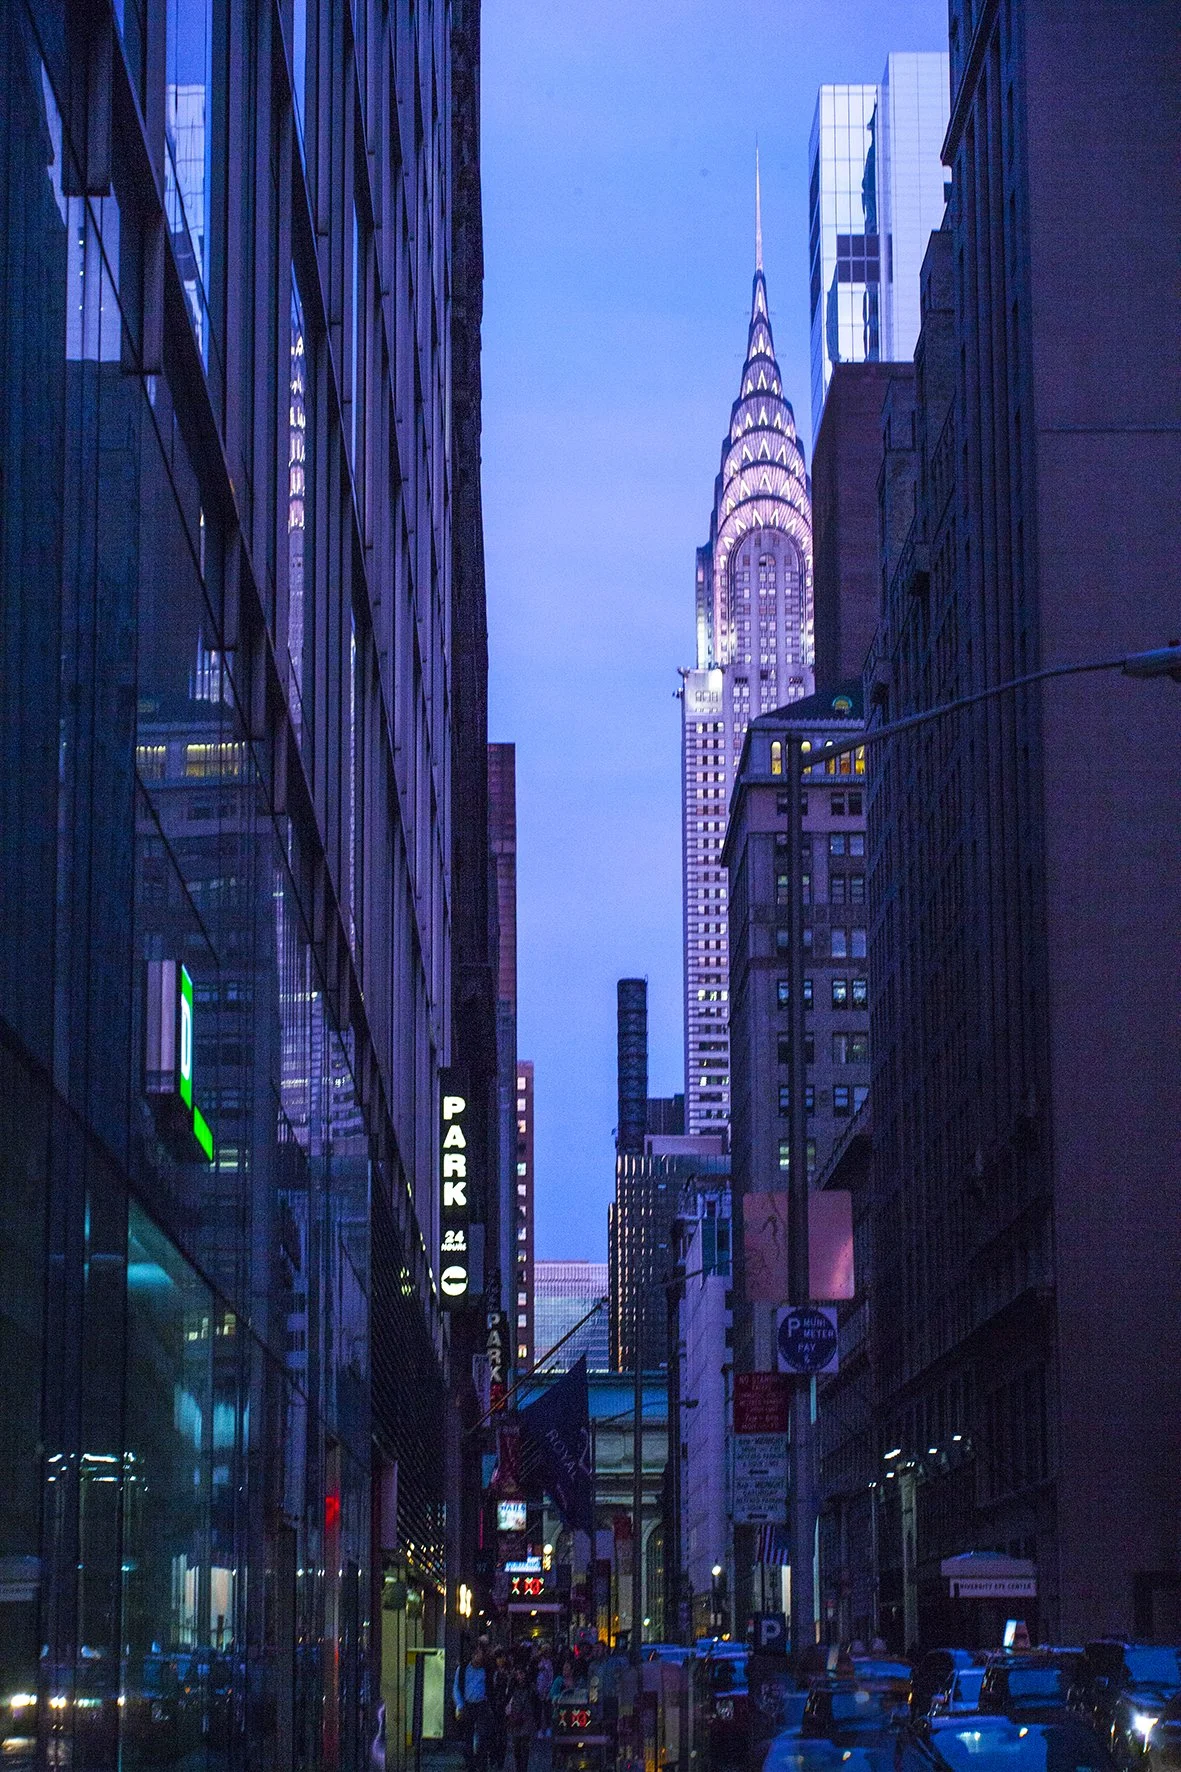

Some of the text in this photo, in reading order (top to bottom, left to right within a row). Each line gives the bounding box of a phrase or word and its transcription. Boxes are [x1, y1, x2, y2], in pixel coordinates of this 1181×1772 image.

[443, 1096, 467, 1206] PARK
[444, 1230, 465, 1244] 24
[486, 1312, 502, 1382] PARK
[788, 1318, 800, 1338] P
